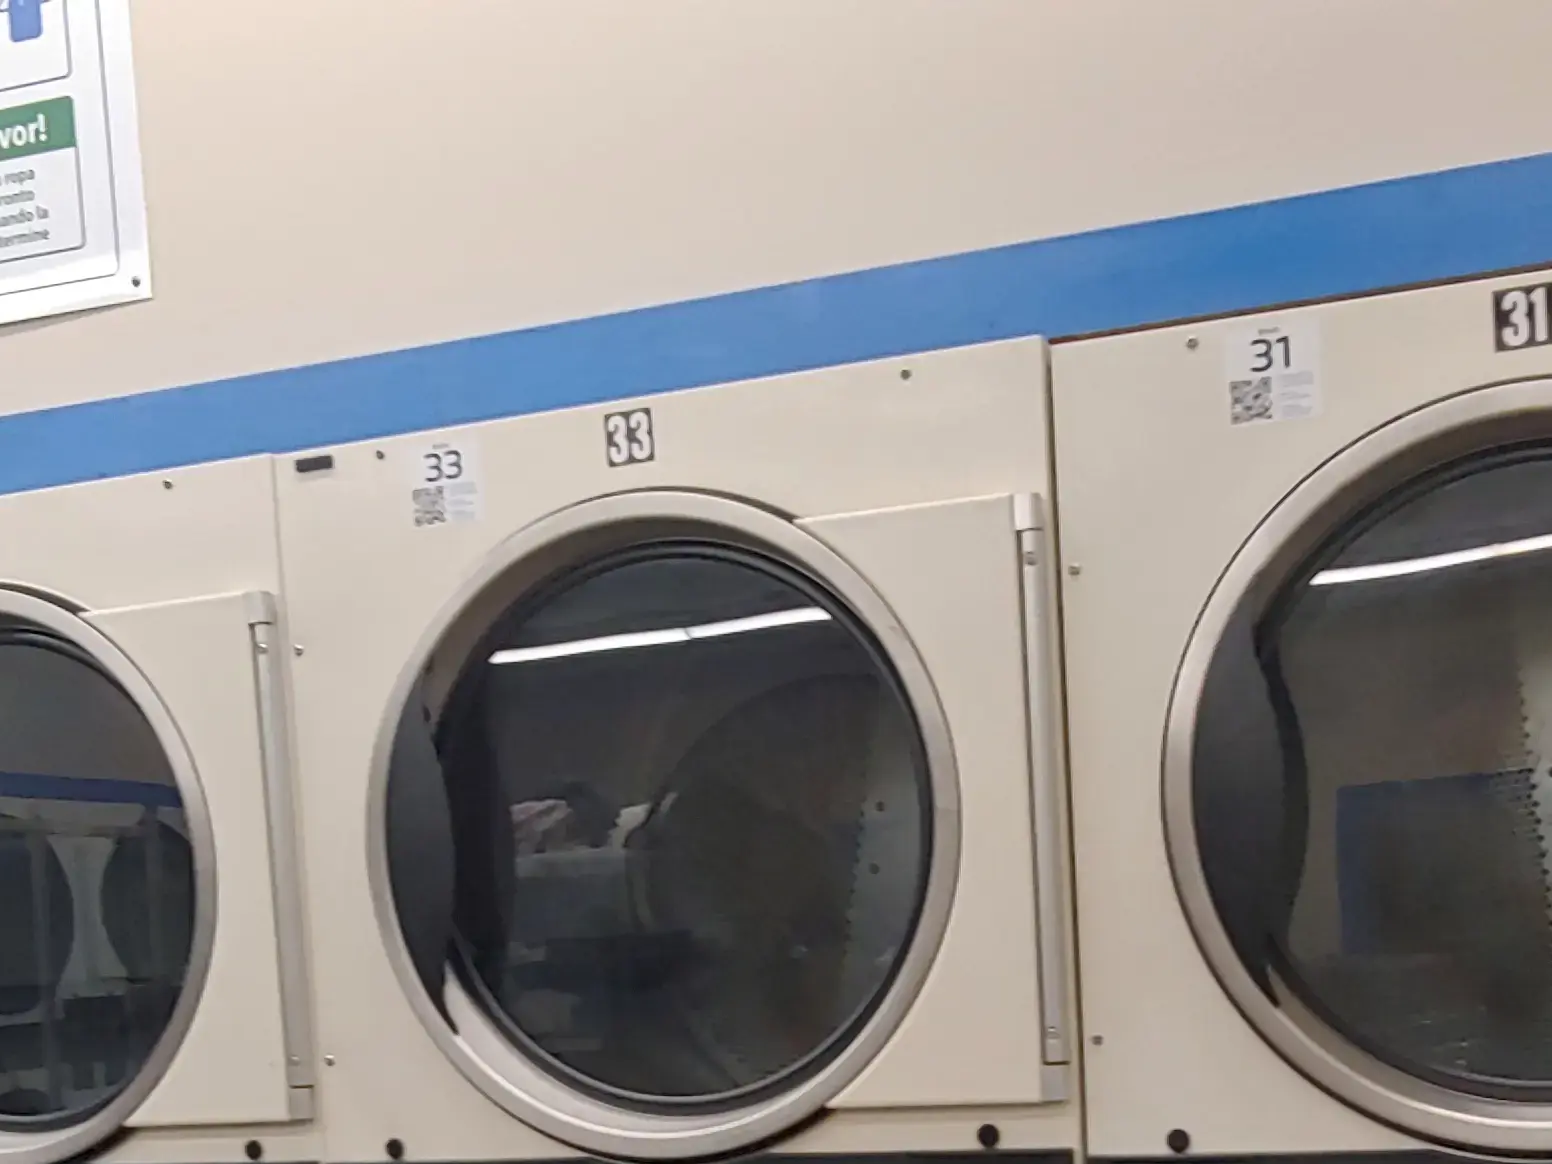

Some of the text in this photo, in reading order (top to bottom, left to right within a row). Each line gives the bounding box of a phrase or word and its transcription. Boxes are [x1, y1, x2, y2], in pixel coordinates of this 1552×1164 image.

[1501, 285, 1551, 348] 31
[1251, 336, 1290, 372] 31
[606, 411, 653, 466] 33
[423, 450, 463, 482] 33
